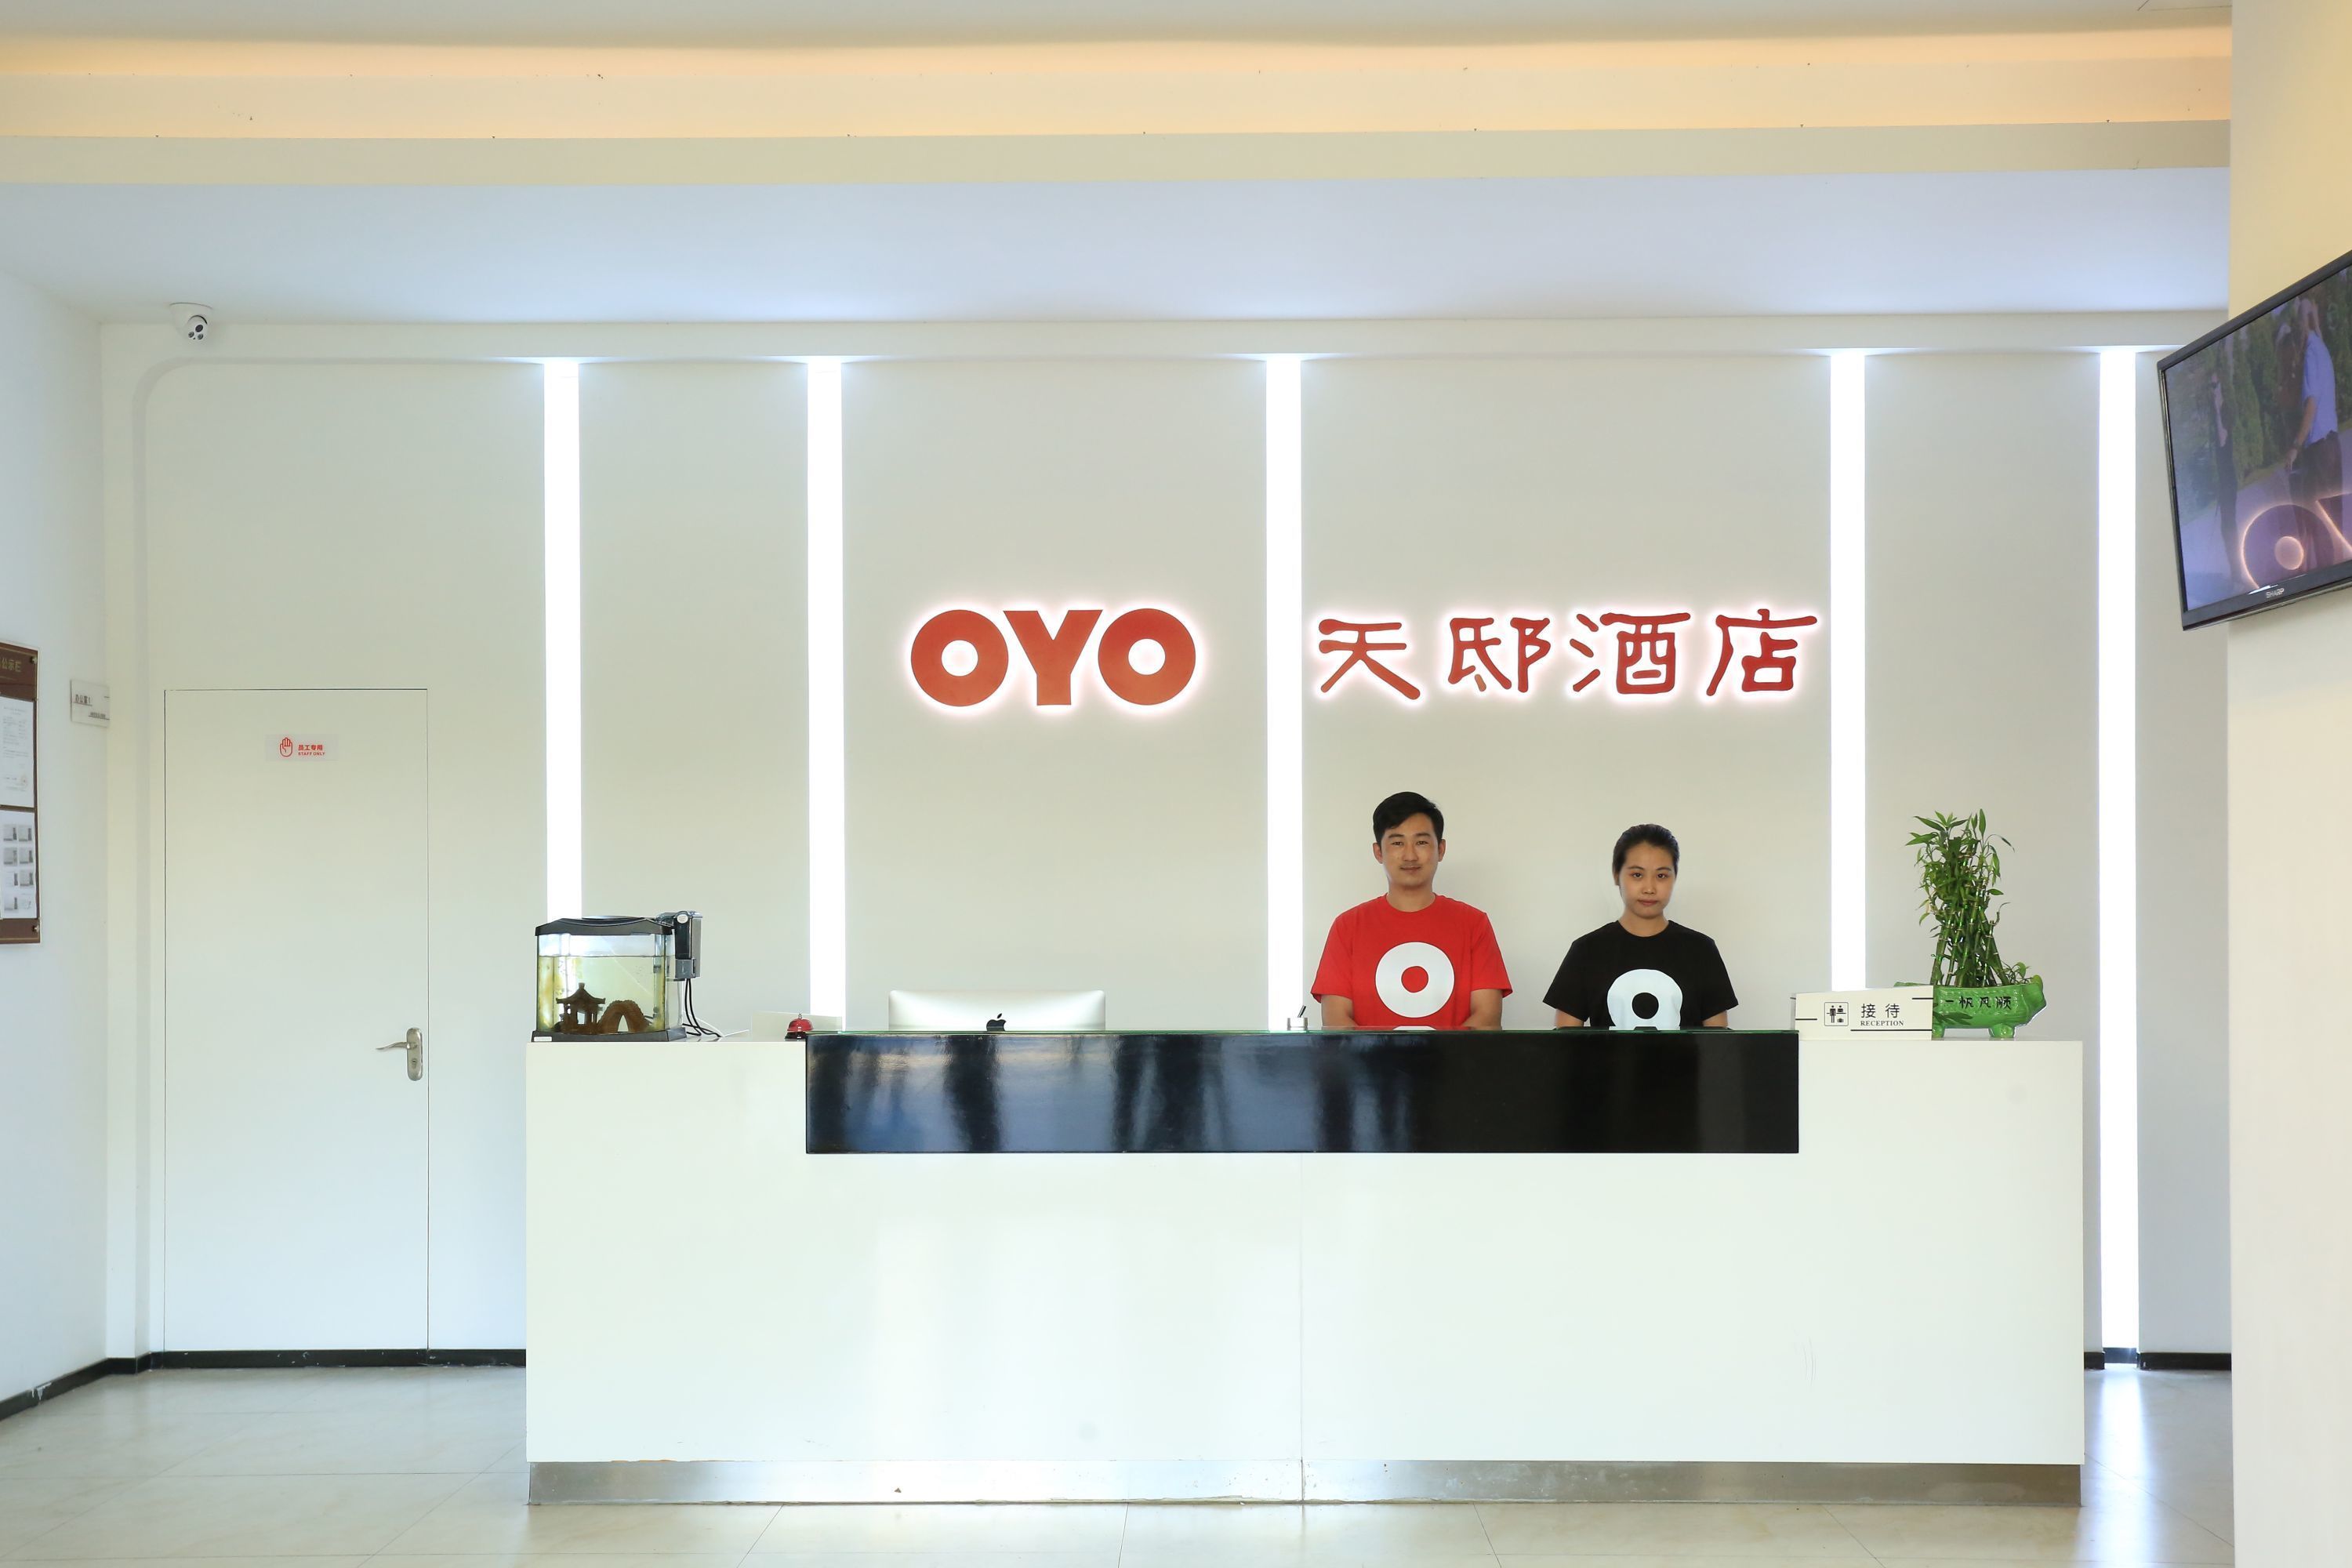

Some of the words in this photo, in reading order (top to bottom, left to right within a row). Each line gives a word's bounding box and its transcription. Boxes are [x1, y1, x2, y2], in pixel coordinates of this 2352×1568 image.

[2266, 588, 2285, 598] SHARP
[910, 608, 1196, 707] OYO
[1318, 608, 1818, 700] 天邸酒店
[1860, 1003, 1900, 1018] 接待
[1945, 995, 2012, 1011] 一帆风顺
